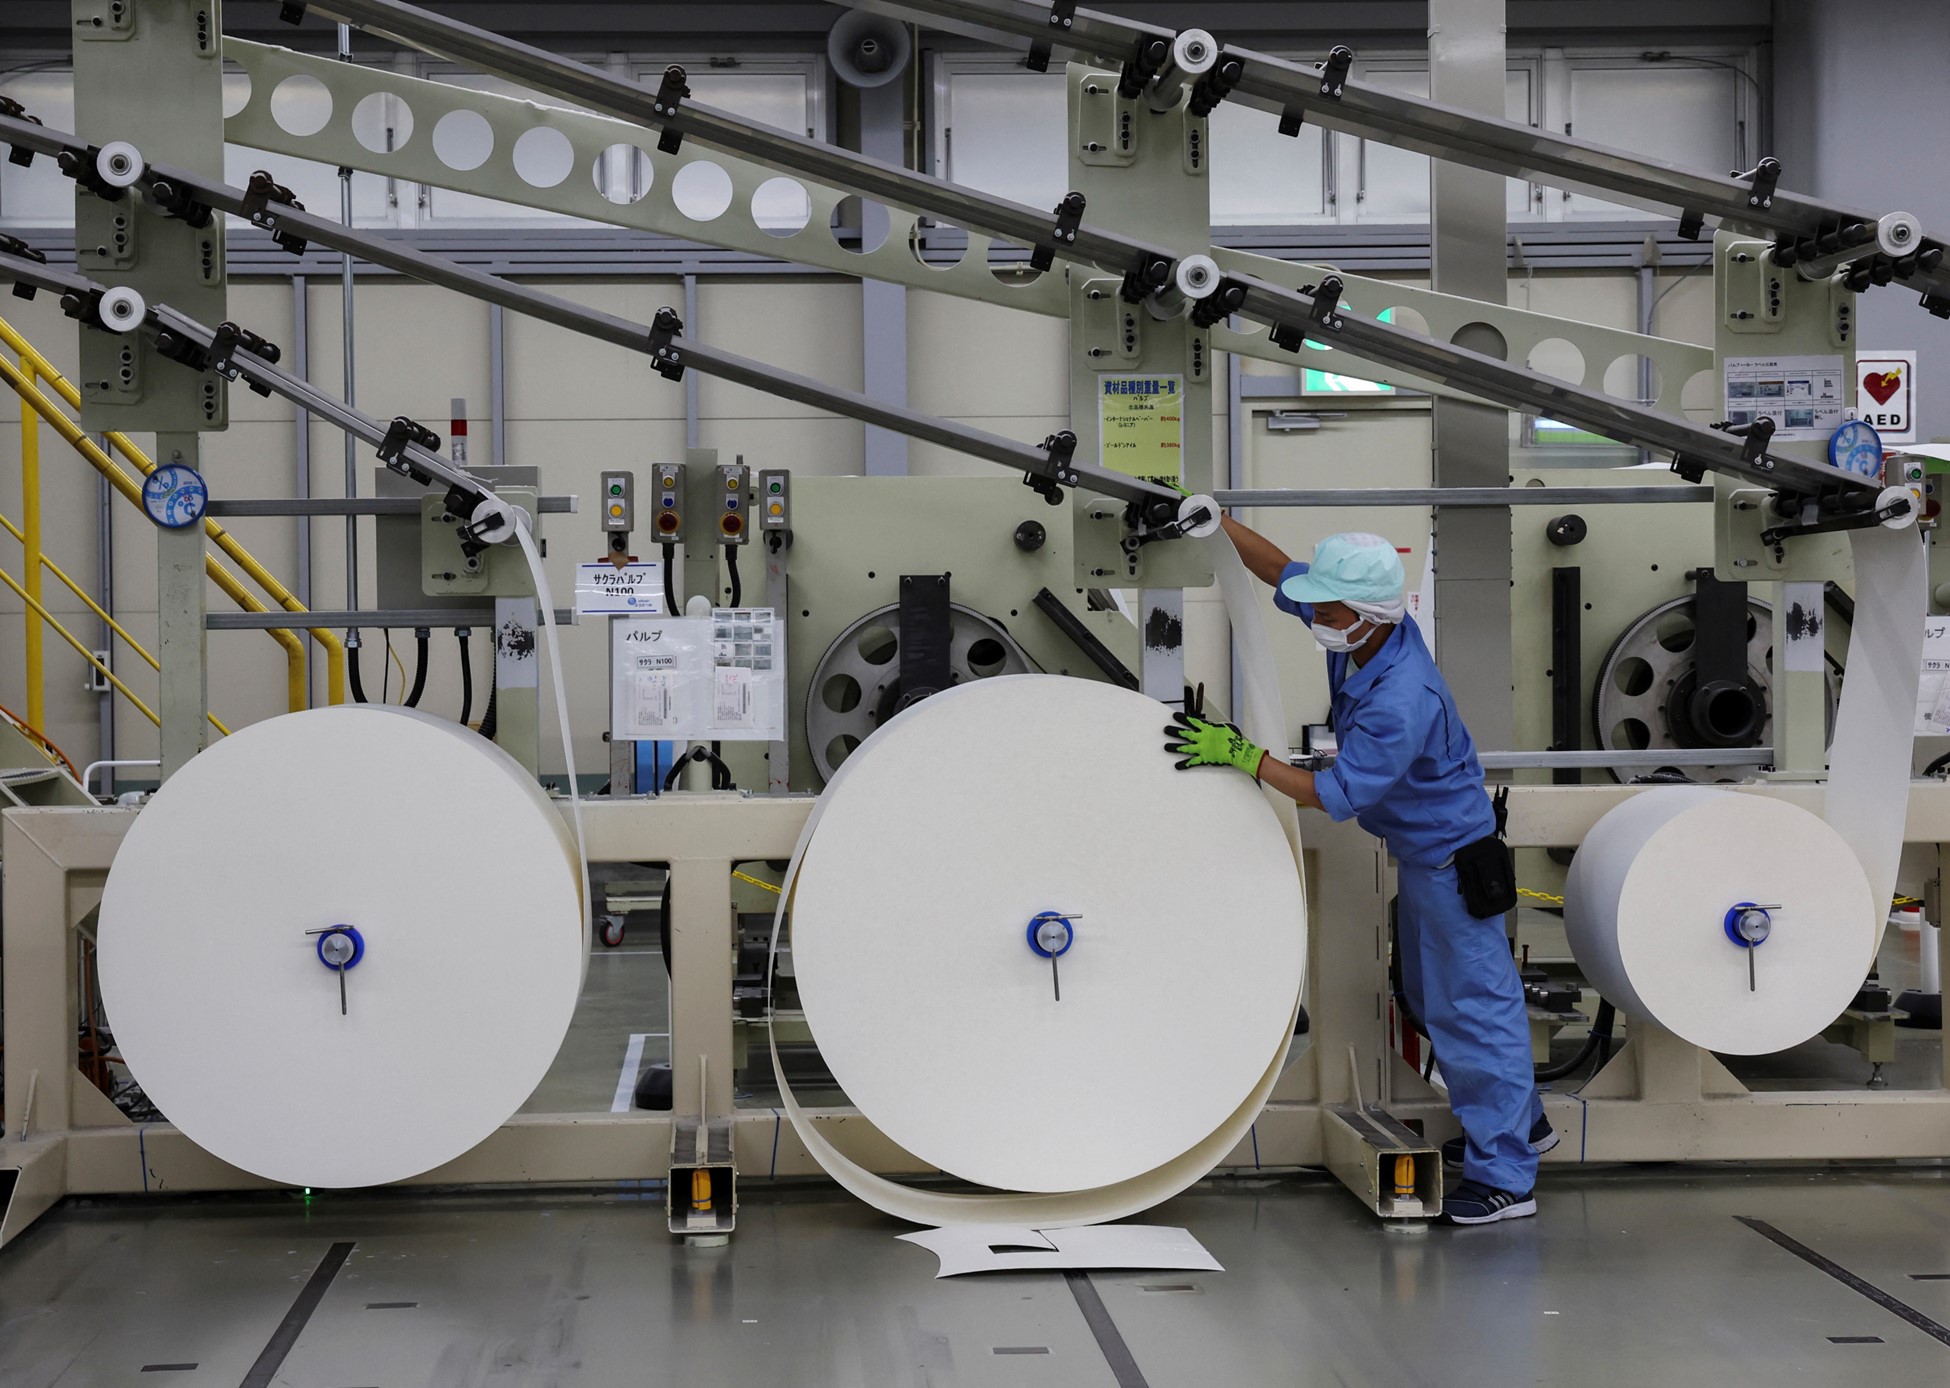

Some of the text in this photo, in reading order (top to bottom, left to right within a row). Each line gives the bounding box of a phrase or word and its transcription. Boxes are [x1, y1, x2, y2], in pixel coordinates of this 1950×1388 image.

[1104, 380, 1176, 394] 資材品種別重量一覧
[1863, 414, 1901, 425] AED
[593, 572, 647, 585] サクラパルプ
[605, 587, 634, 597] N100
[626, 629, 663, 642] パルプ
[1925, 627, 1946, 638] ルプ
[638, 657, 673, 666] サクラ N100
